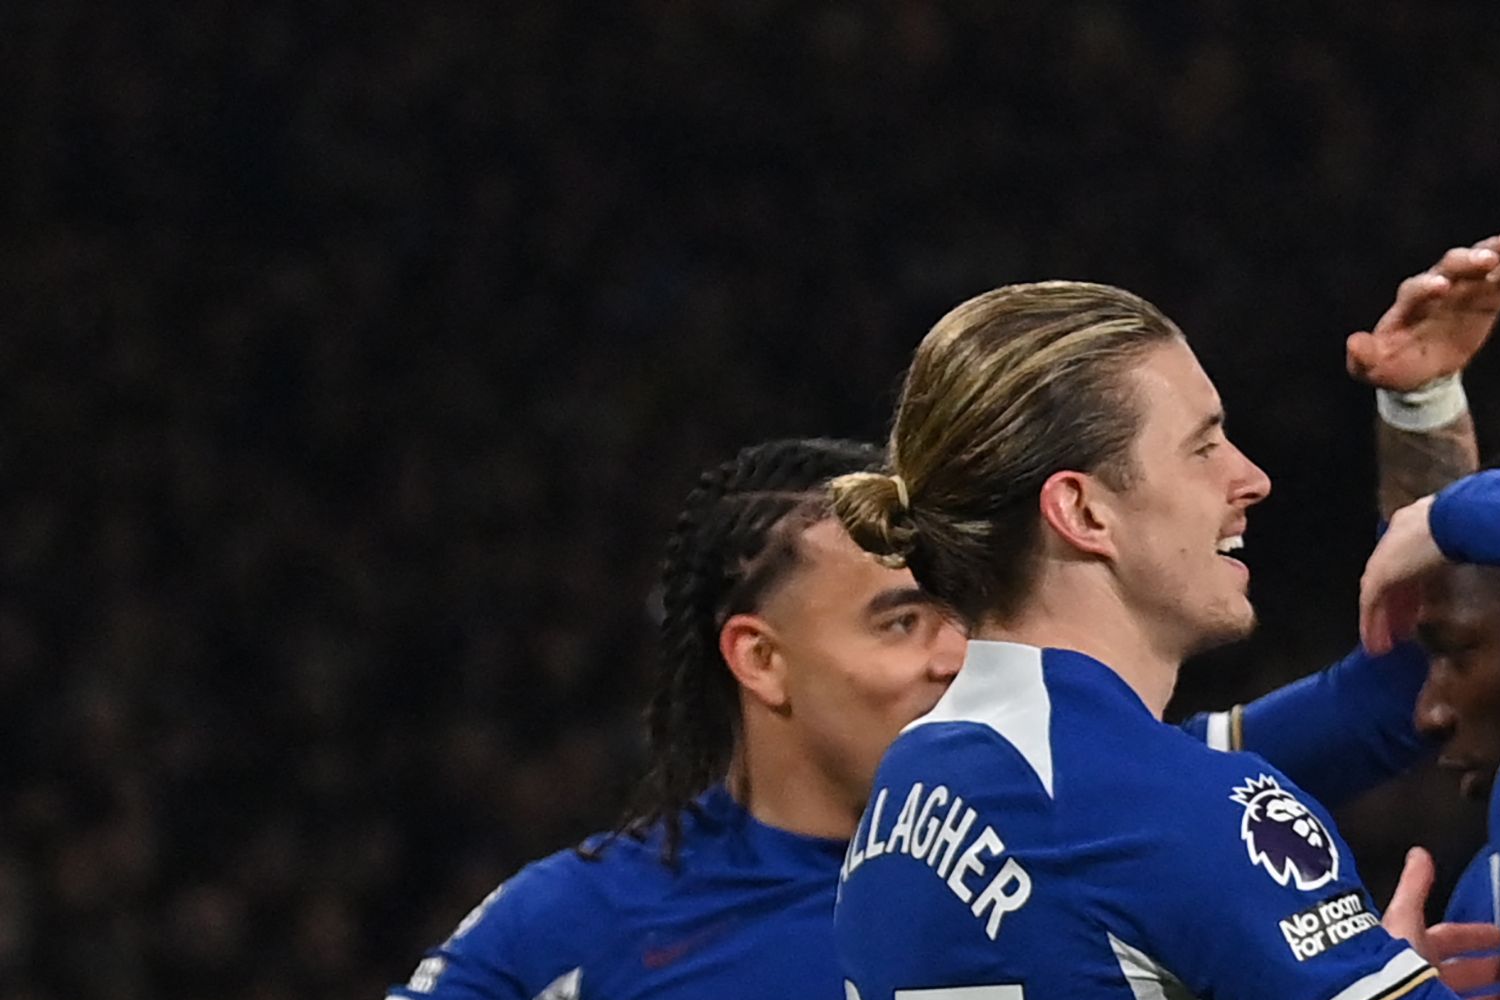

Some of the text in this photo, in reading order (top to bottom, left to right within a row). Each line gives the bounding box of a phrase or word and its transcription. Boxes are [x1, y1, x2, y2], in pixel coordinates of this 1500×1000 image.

[837, 782, 1033, 941] LLAGHER
[1279, 893, 1363, 943] No room
[1289, 930, 1326, 961] for
